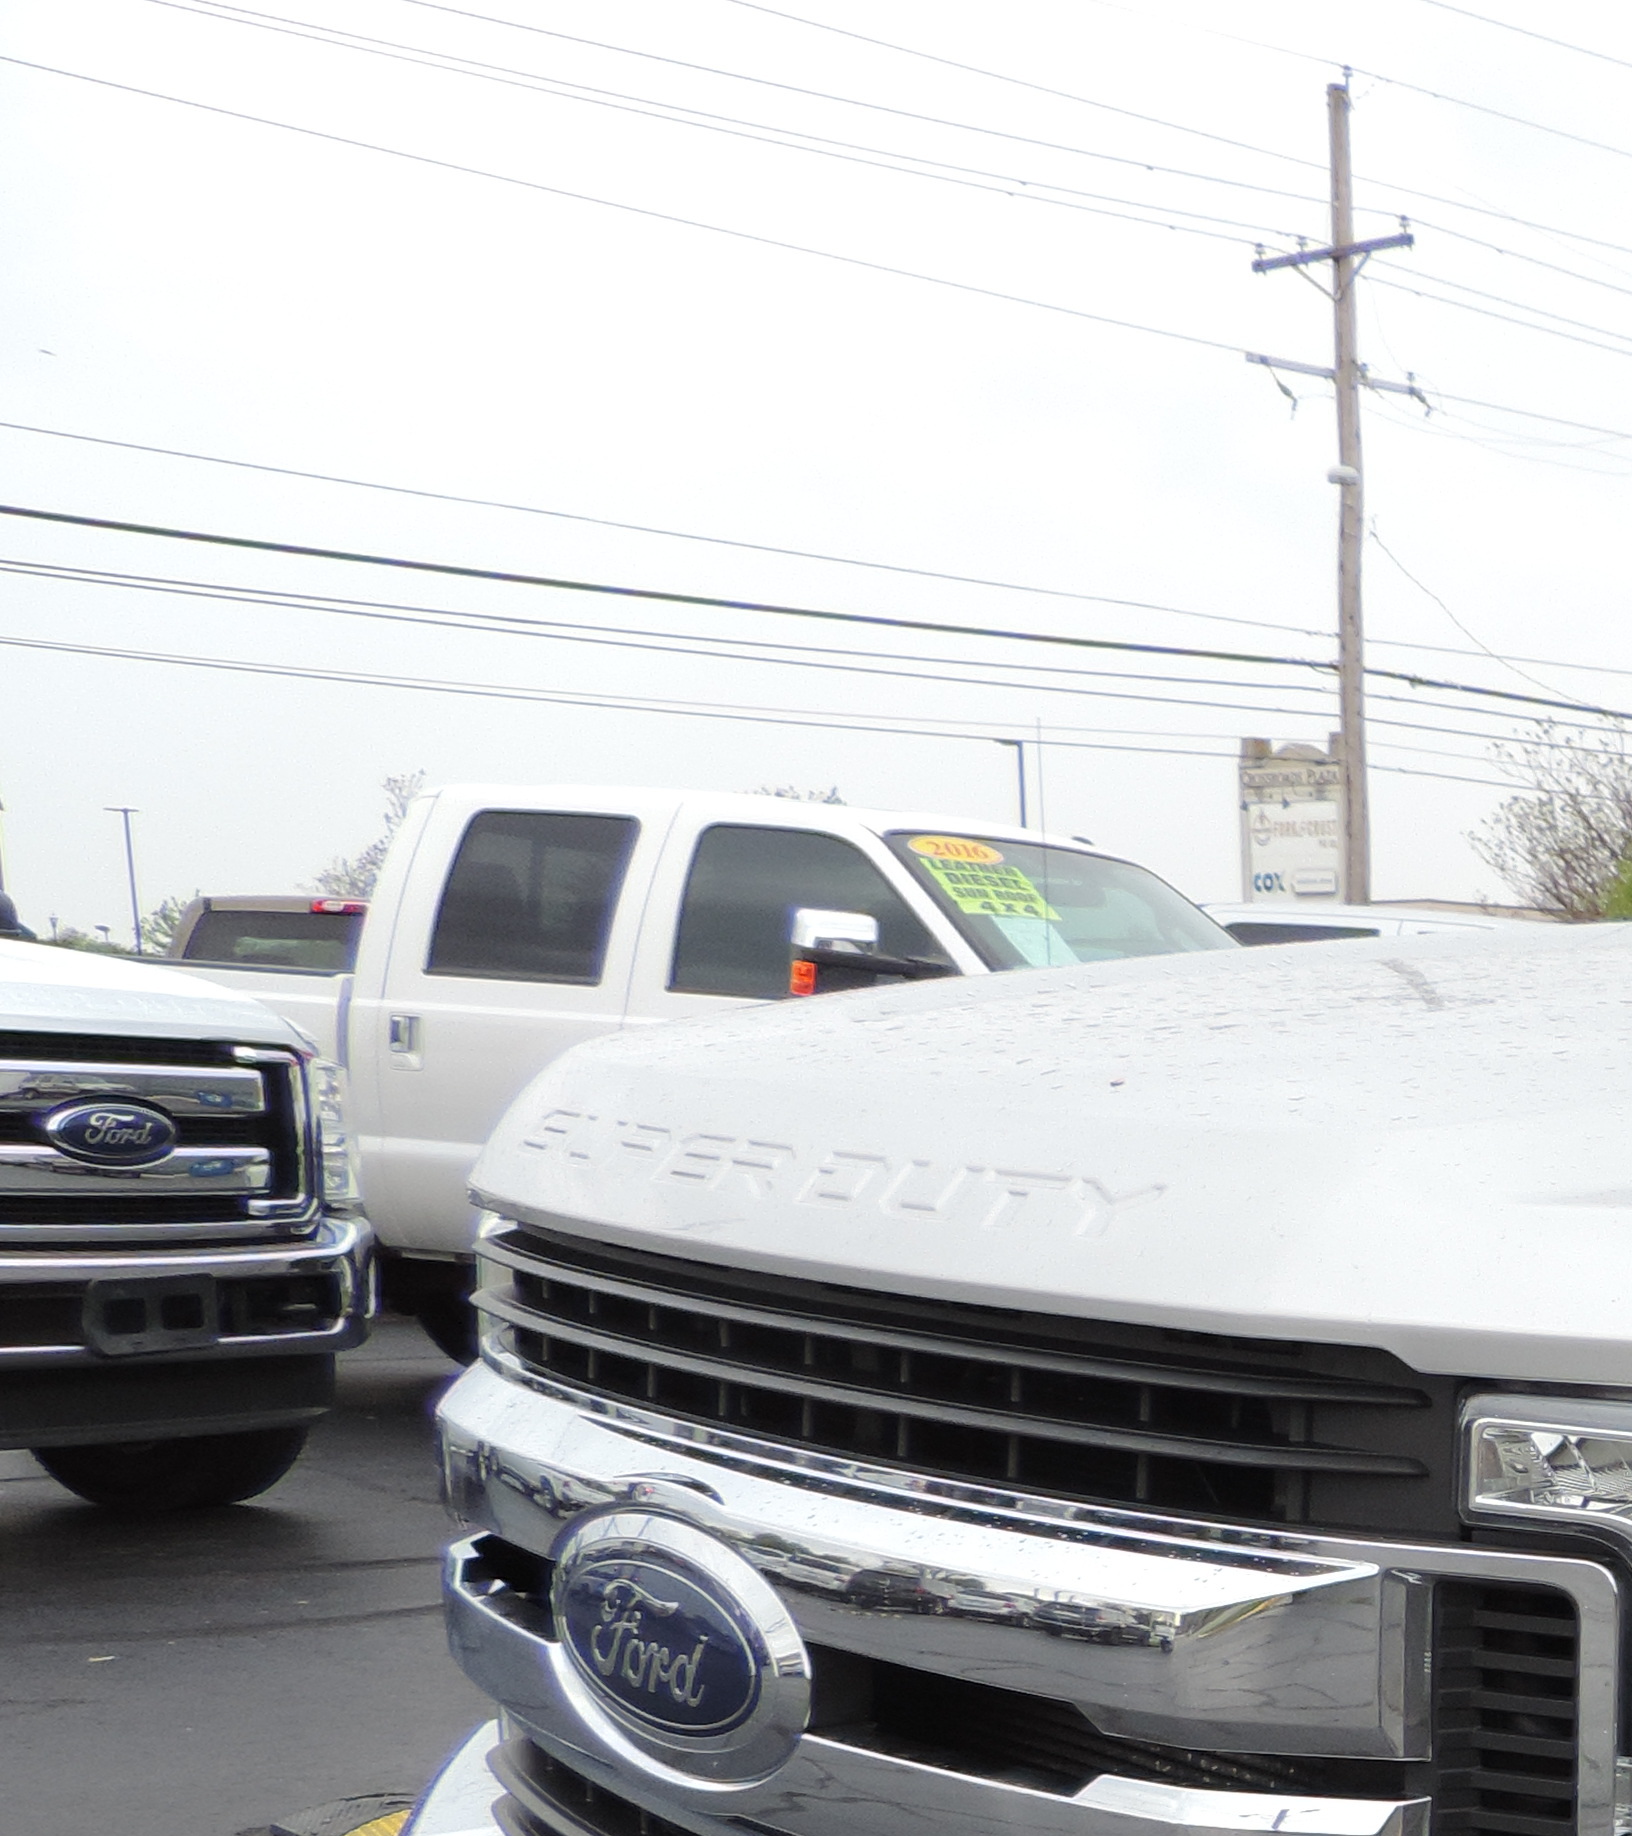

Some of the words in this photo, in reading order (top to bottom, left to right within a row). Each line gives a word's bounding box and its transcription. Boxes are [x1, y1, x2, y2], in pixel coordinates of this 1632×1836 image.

[926, 840, 988, 859] 2016
[945, 872, 1029, 891] DIESEL
[84, 1112, 154, 1145] Ford
[522, 1107, 797, 1200] SUPER
[798, 1147, 1168, 1238] DUTY
[590, 1578, 710, 1708] Ford
